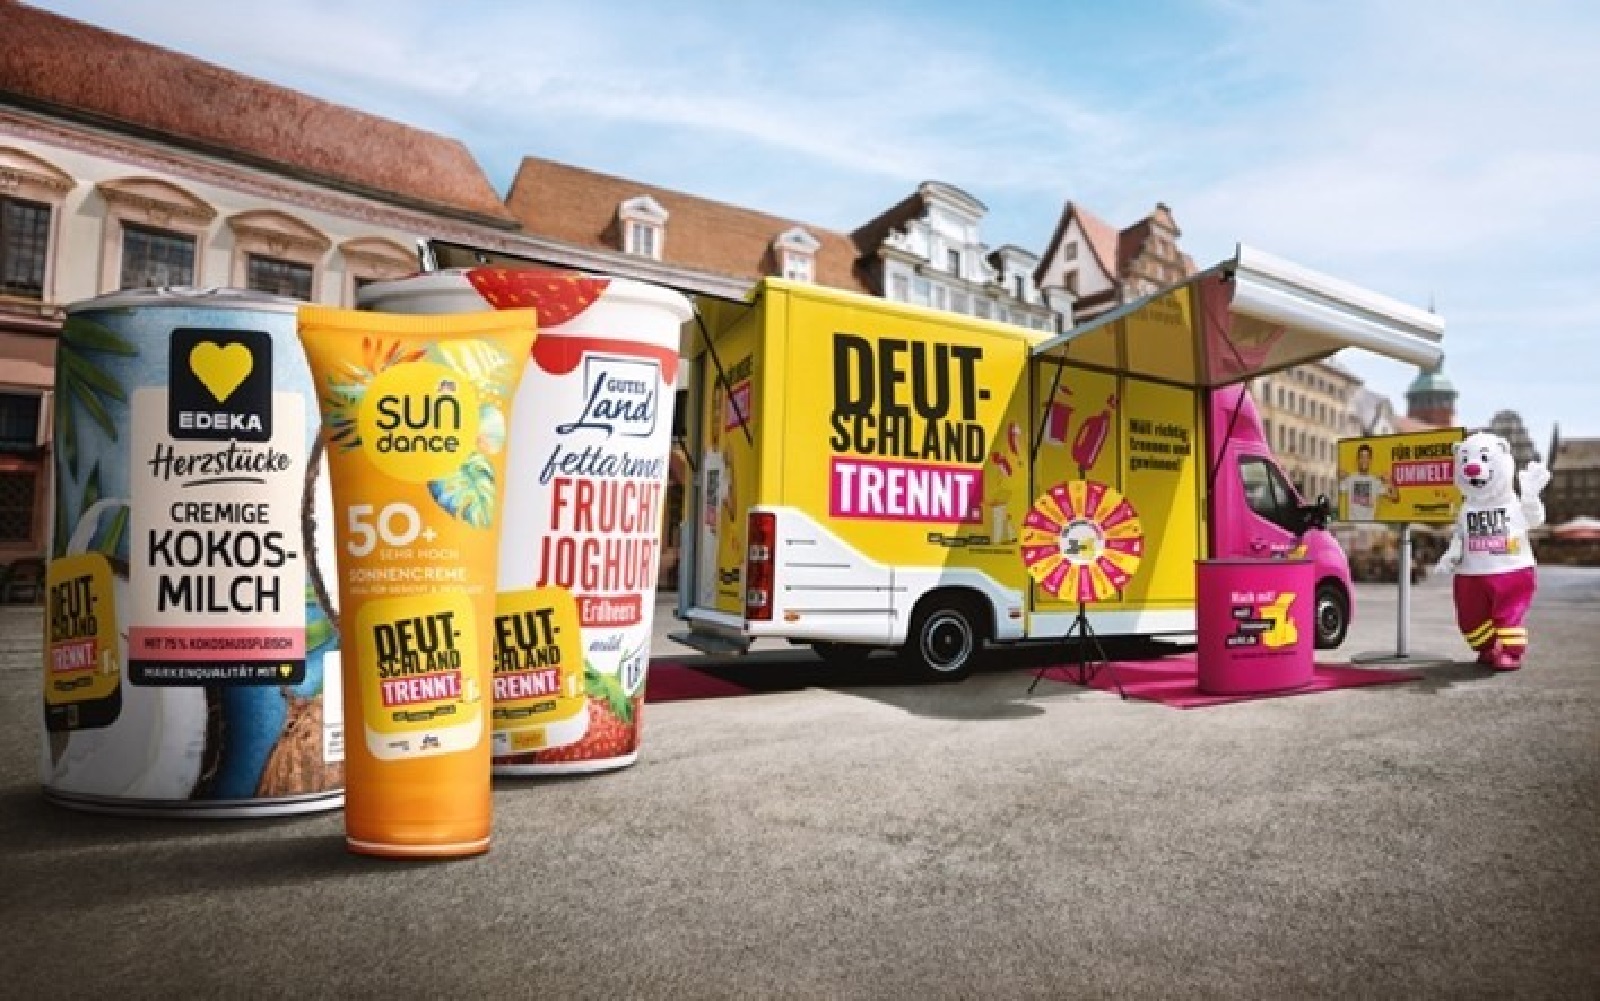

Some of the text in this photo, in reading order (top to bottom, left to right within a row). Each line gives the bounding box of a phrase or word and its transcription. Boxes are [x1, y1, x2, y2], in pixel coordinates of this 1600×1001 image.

[832, 333, 991, 421] DEUT-
[178, 410, 263, 432] EDEKA
[376, 394, 461, 430] sun
[556, 371, 654, 439] Land
[376, 433, 460, 453] dance
[829, 407, 987, 463] SCHLAND
[147, 438, 292, 481] Herzstücke
[539, 444, 664, 486] fettarme
[550, 477, 661, 533] FRUCHT
[835, 463, 981, 520] TRENNT.
[170, 502, 270, 525] CREMIGE
[149, 529, 297, 567] KOKOS-
[349, 566, 467, 582] SONNENCREME
[157, 575, 281, 613] MILCH
[372, 610, 462, 662] DEUT-
[494, 606, 561, 656] EUT-
[378, 648, 462, 678] SCHLAND
[382, 674, 461, 705] TRENNT.
[494, 669, 561, 699] RENNT.
